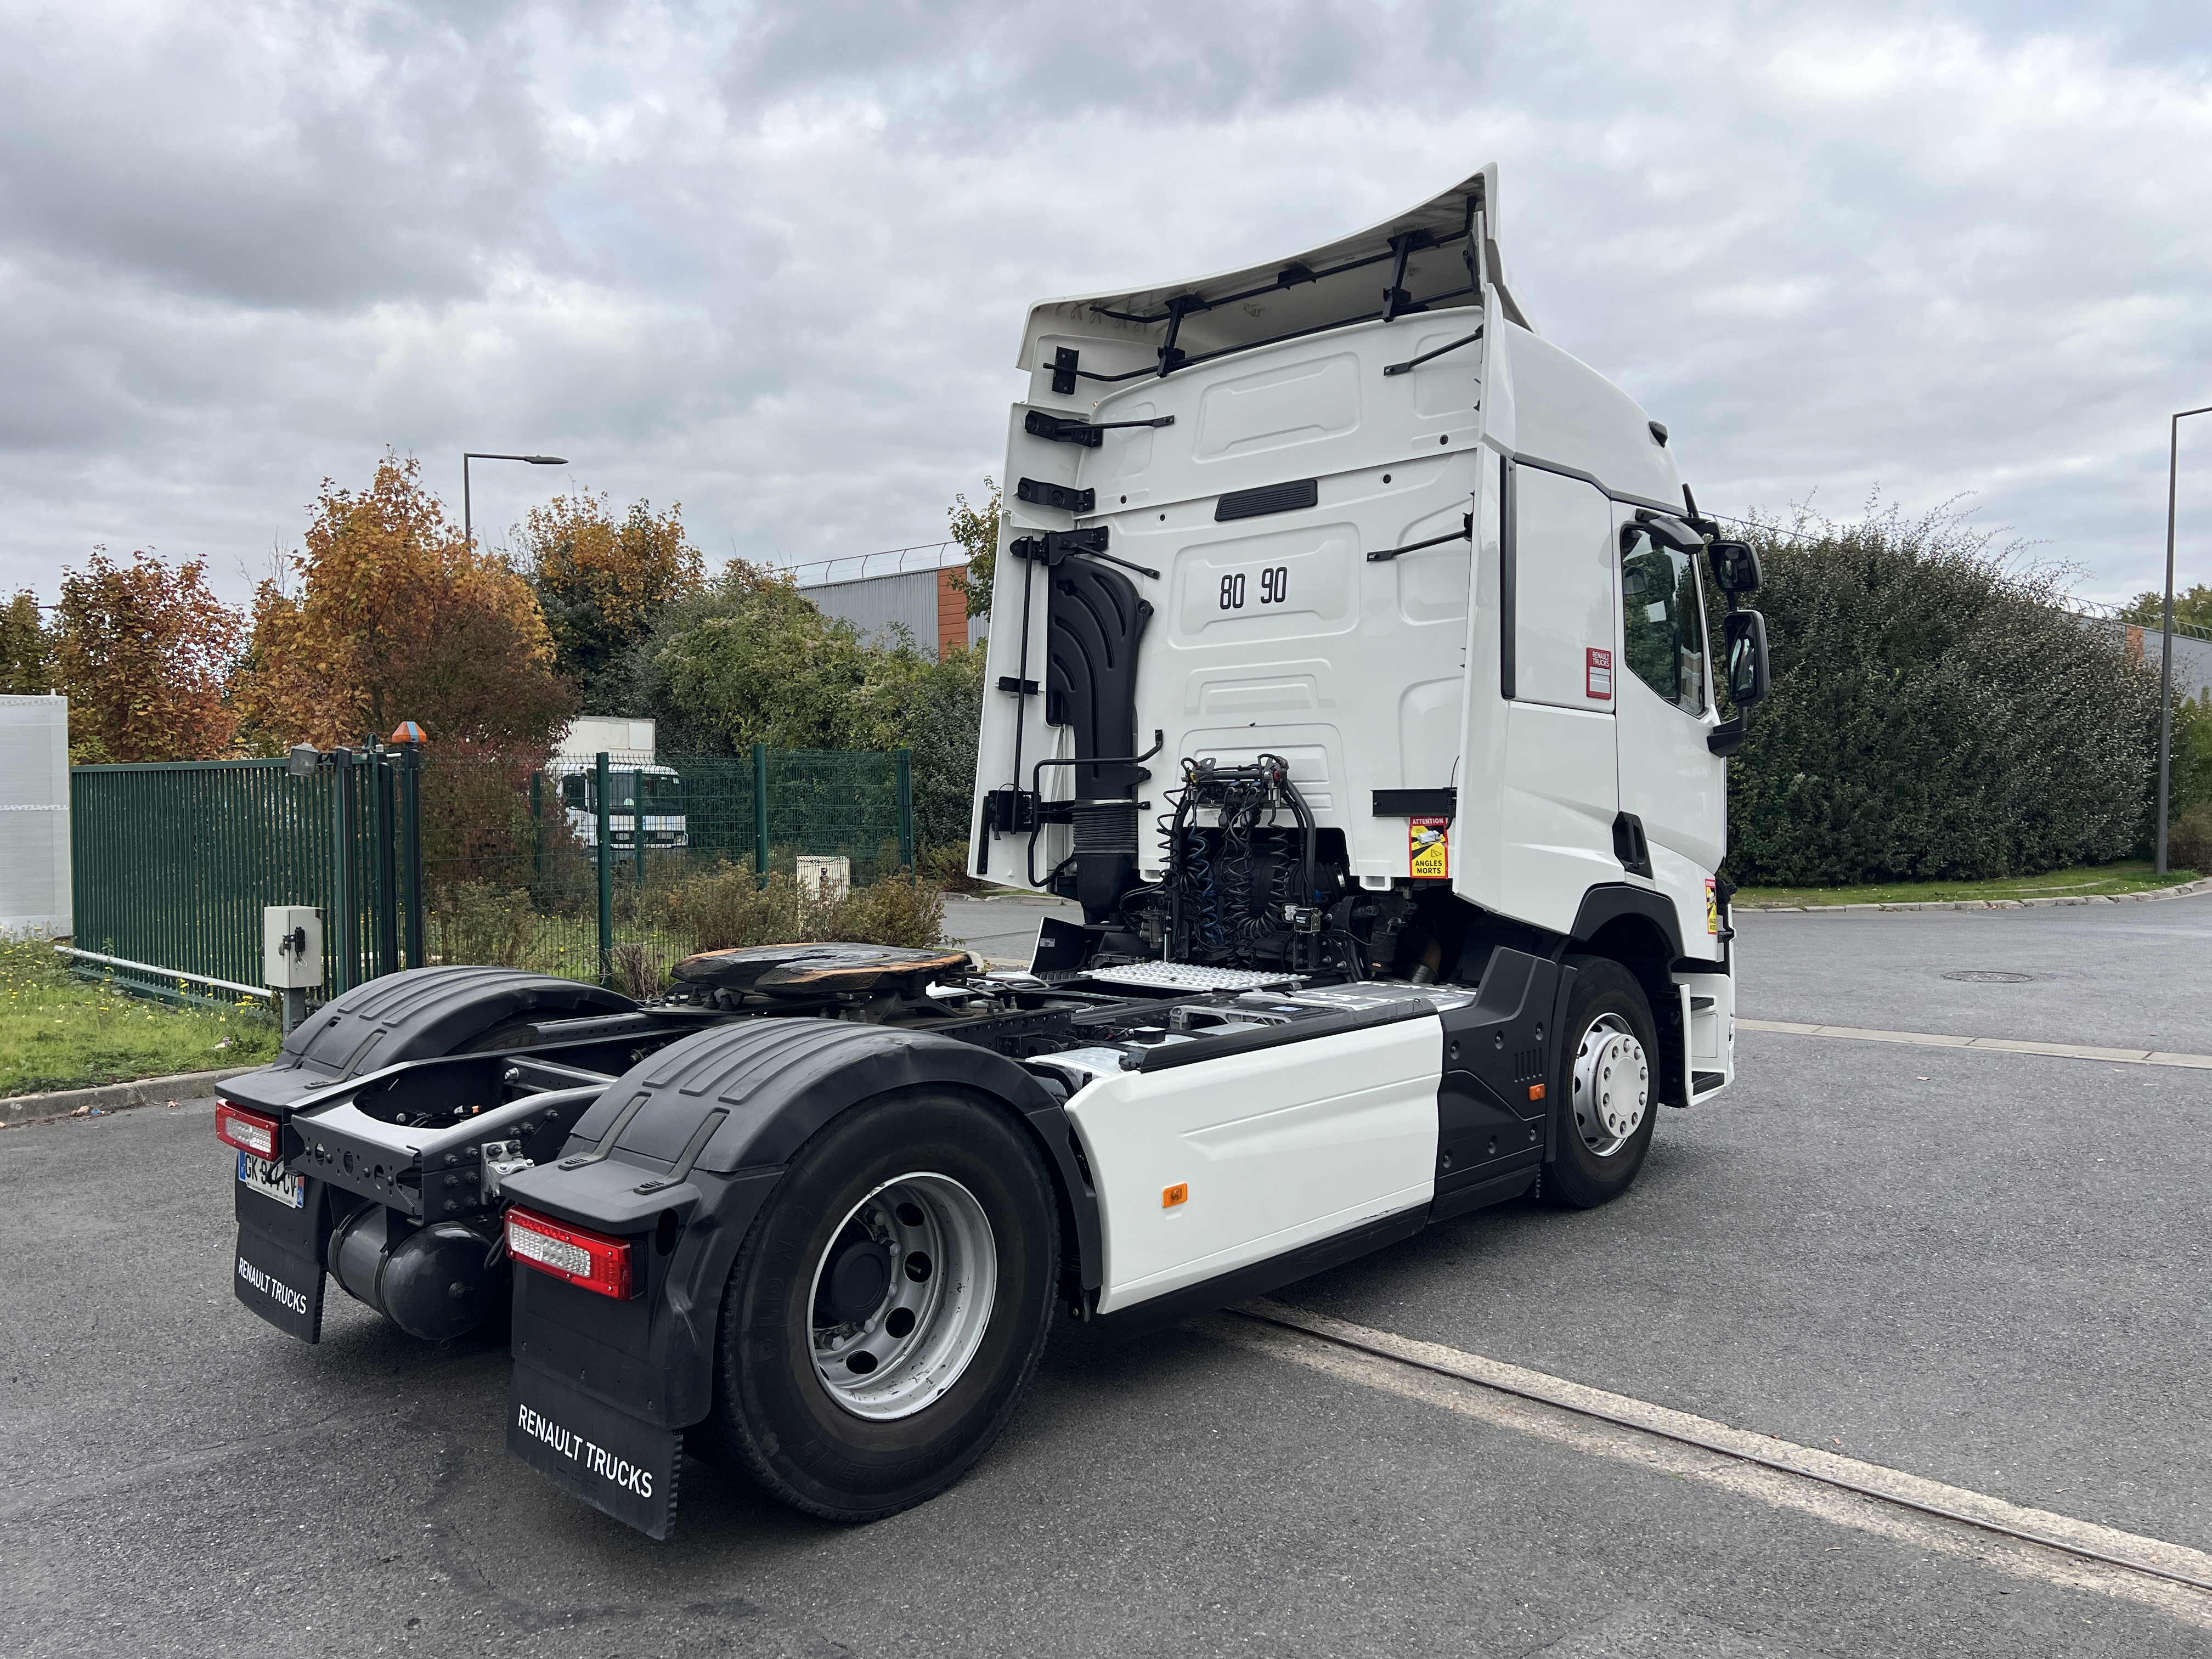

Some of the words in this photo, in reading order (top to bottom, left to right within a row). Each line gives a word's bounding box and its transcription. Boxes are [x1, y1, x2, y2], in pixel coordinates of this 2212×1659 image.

[1220, 573, 1245, 610] 80
[1260, 567, 1288, 604] 90
[1592, 651, 1610, 661] RENAULT
[1592, 658, 1610, 667] TRUCKS
[238, 1256, 270, 1294] RENAULT
[271, 1278, 307, 1314] TRUCKS
[518, 1403, 583, 1461] RENAULT
[586, 1441, 653, 1498] TRUCKS
